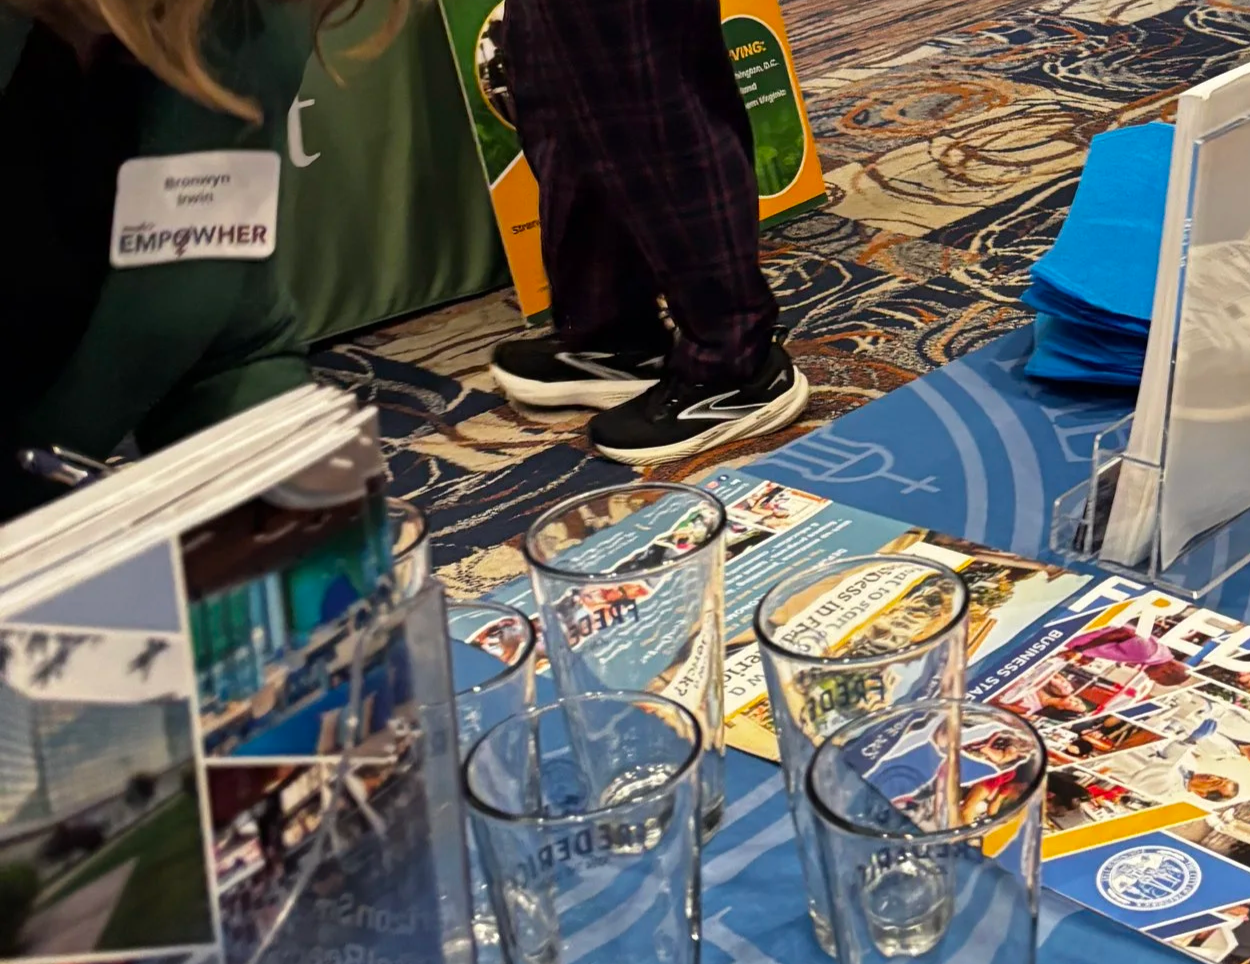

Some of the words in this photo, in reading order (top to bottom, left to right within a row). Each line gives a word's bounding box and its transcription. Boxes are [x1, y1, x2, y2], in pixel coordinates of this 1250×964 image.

[729, 41, 767, 61] VING:
[165, 174, 231, 191] Bronwyn
[176, 192, 213, 206] Irwin
[119, 224, 267, 255] EMPOWHER
[996, 629, 1064, 677] BUSINESS
